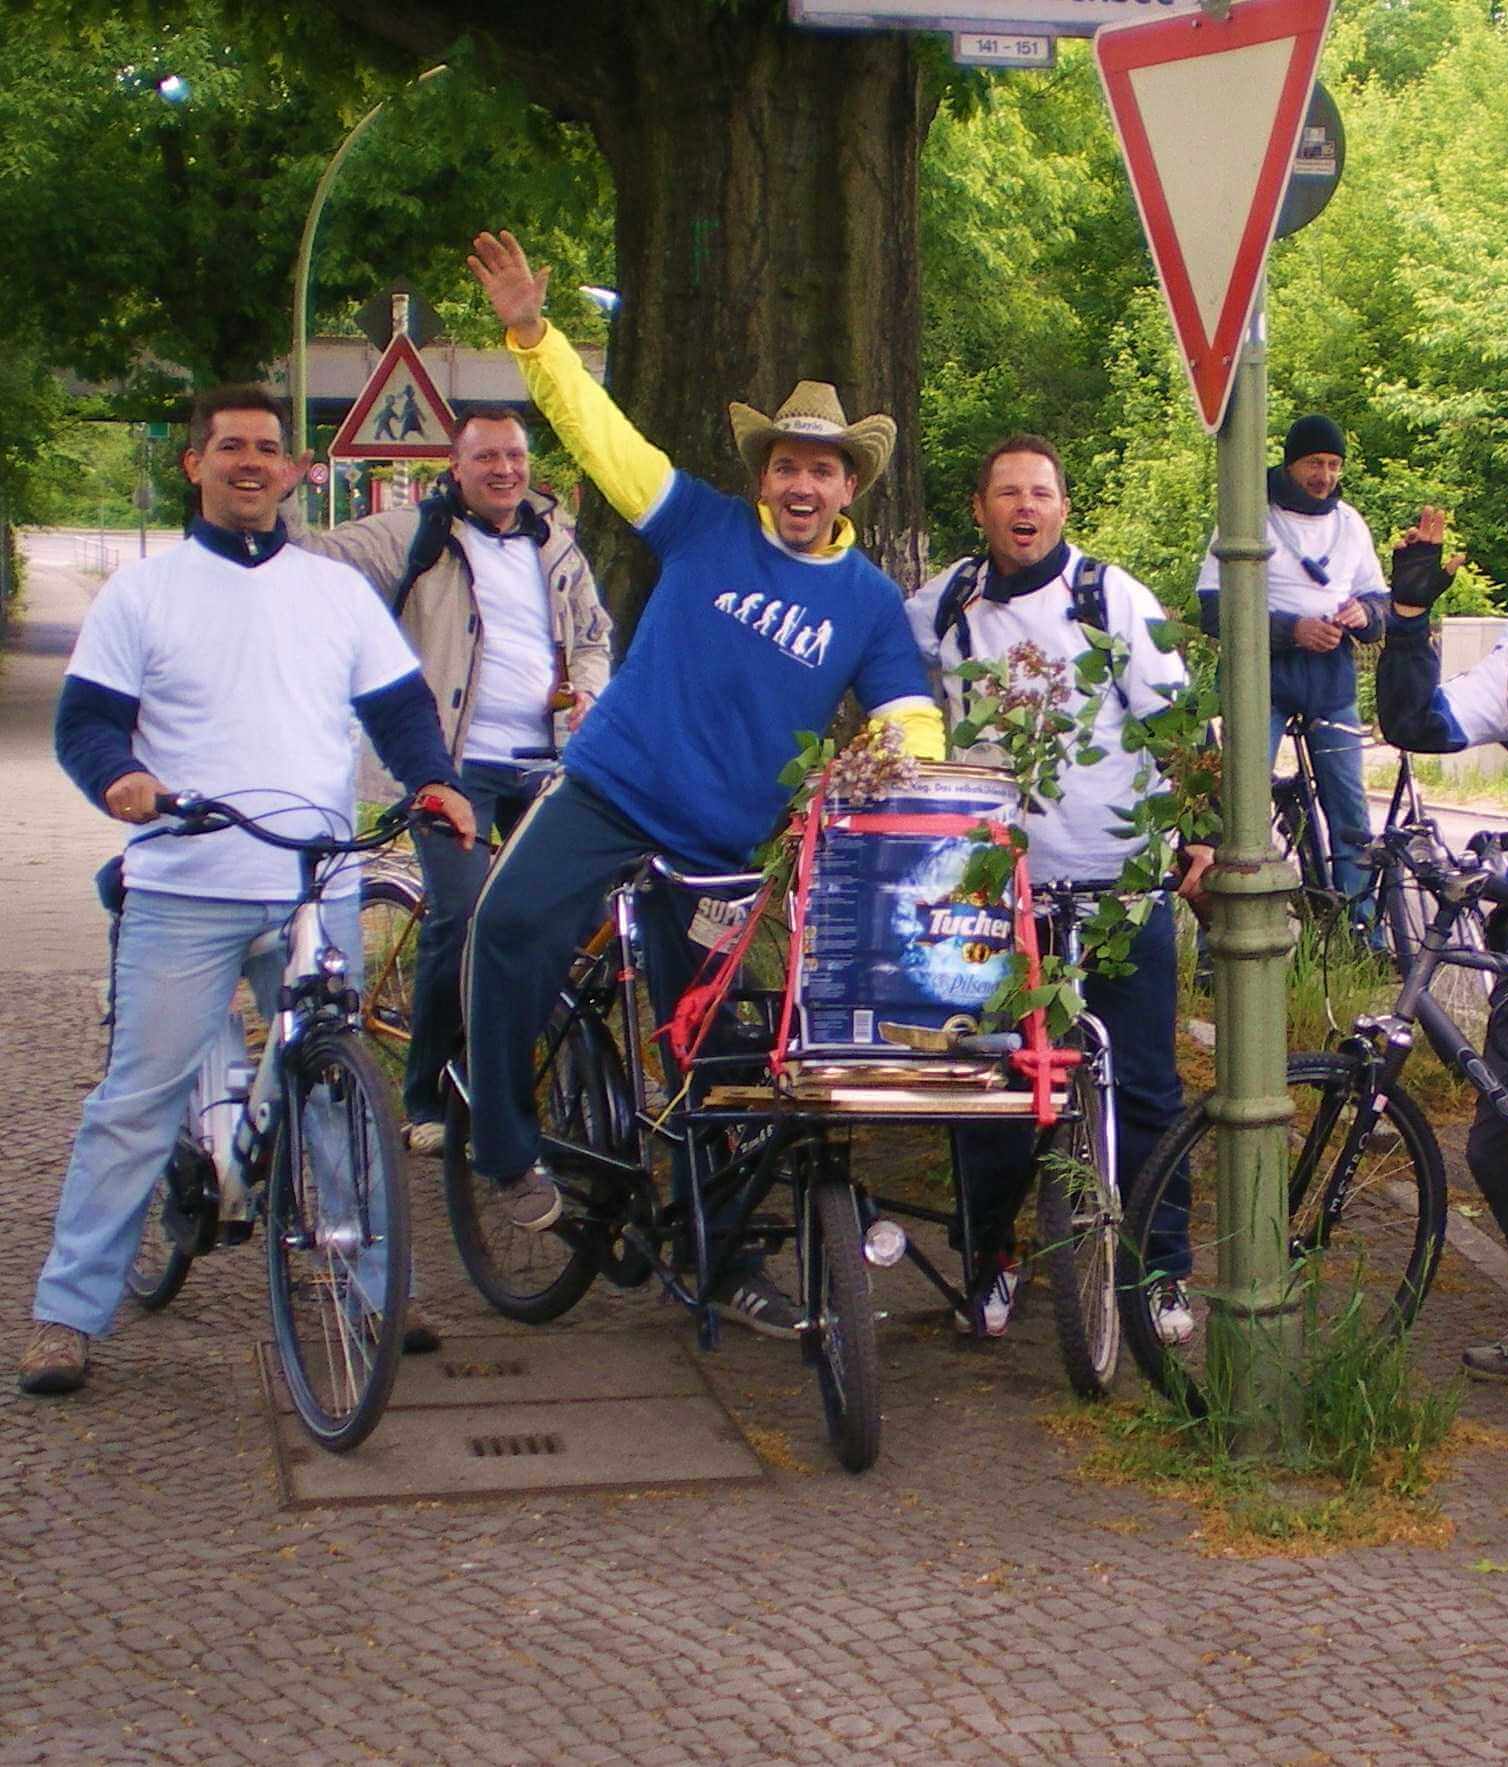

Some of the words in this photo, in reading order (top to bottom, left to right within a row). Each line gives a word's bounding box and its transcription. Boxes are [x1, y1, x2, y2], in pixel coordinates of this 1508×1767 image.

[976, 39, 998, 54] 141
[1015, 40, 1038, 55] 151
[928, 908, 1011, 939] Tucher
